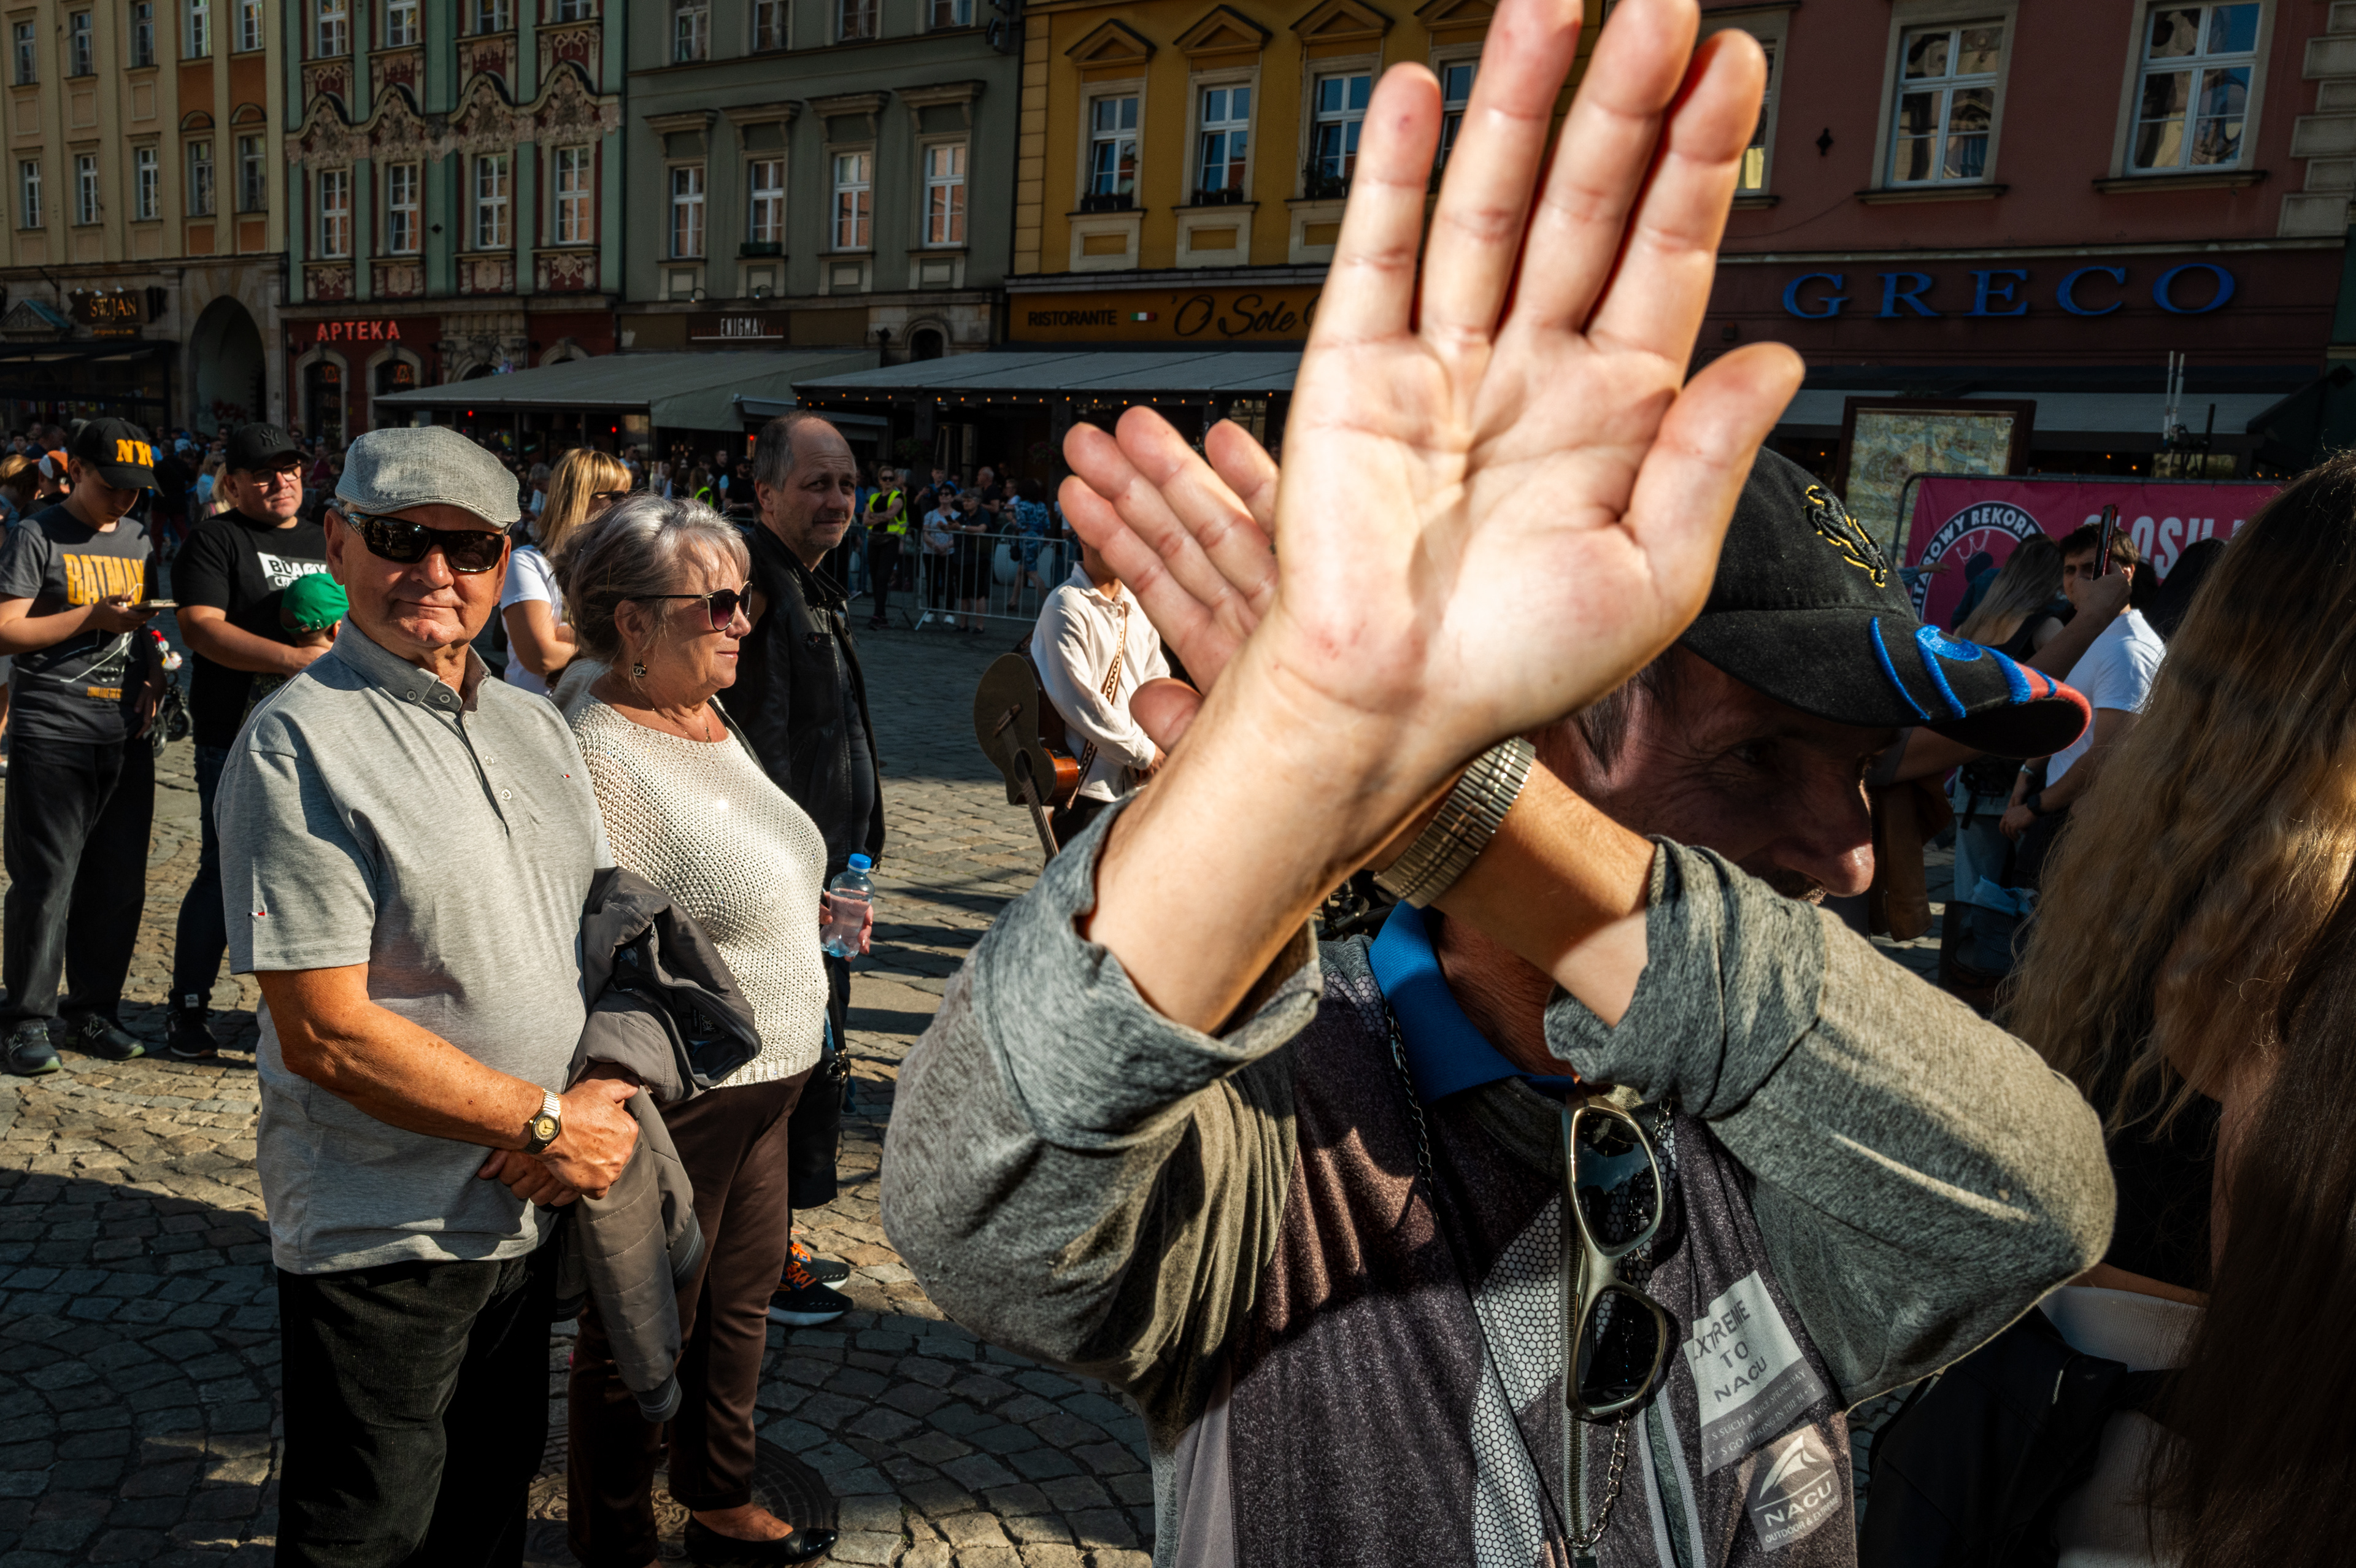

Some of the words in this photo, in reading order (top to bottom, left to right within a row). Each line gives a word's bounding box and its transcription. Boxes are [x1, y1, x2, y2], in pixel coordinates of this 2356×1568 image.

[1782, 263, 2236, 318] GRECO
[111, 297, 137, 321] JAN
[1028, 310, 1118, 326] RISTORANTE
[1218, 294, 1298, 336] Sole
[317, 320, 401, 342] APTEKA
[720, 318, 758, 337] ENIGMA
[63, 553, 145, 607] BATMAN
[1694, 1299, 1751, 1361] XTREME
[1720, 1341, 1749, 1369] TO
[1714, 1356, 1767, 1402] NACU
[1719, 1418, 1745, 1437] SUCH
[1790, 1369, 1806, 1385] DAY
[1729, 1438, 1744, 1451] GO
[1764, 1481, 1831, 1527] NACU
[1765, 1521, 1806, 1543] OUTDOOR
